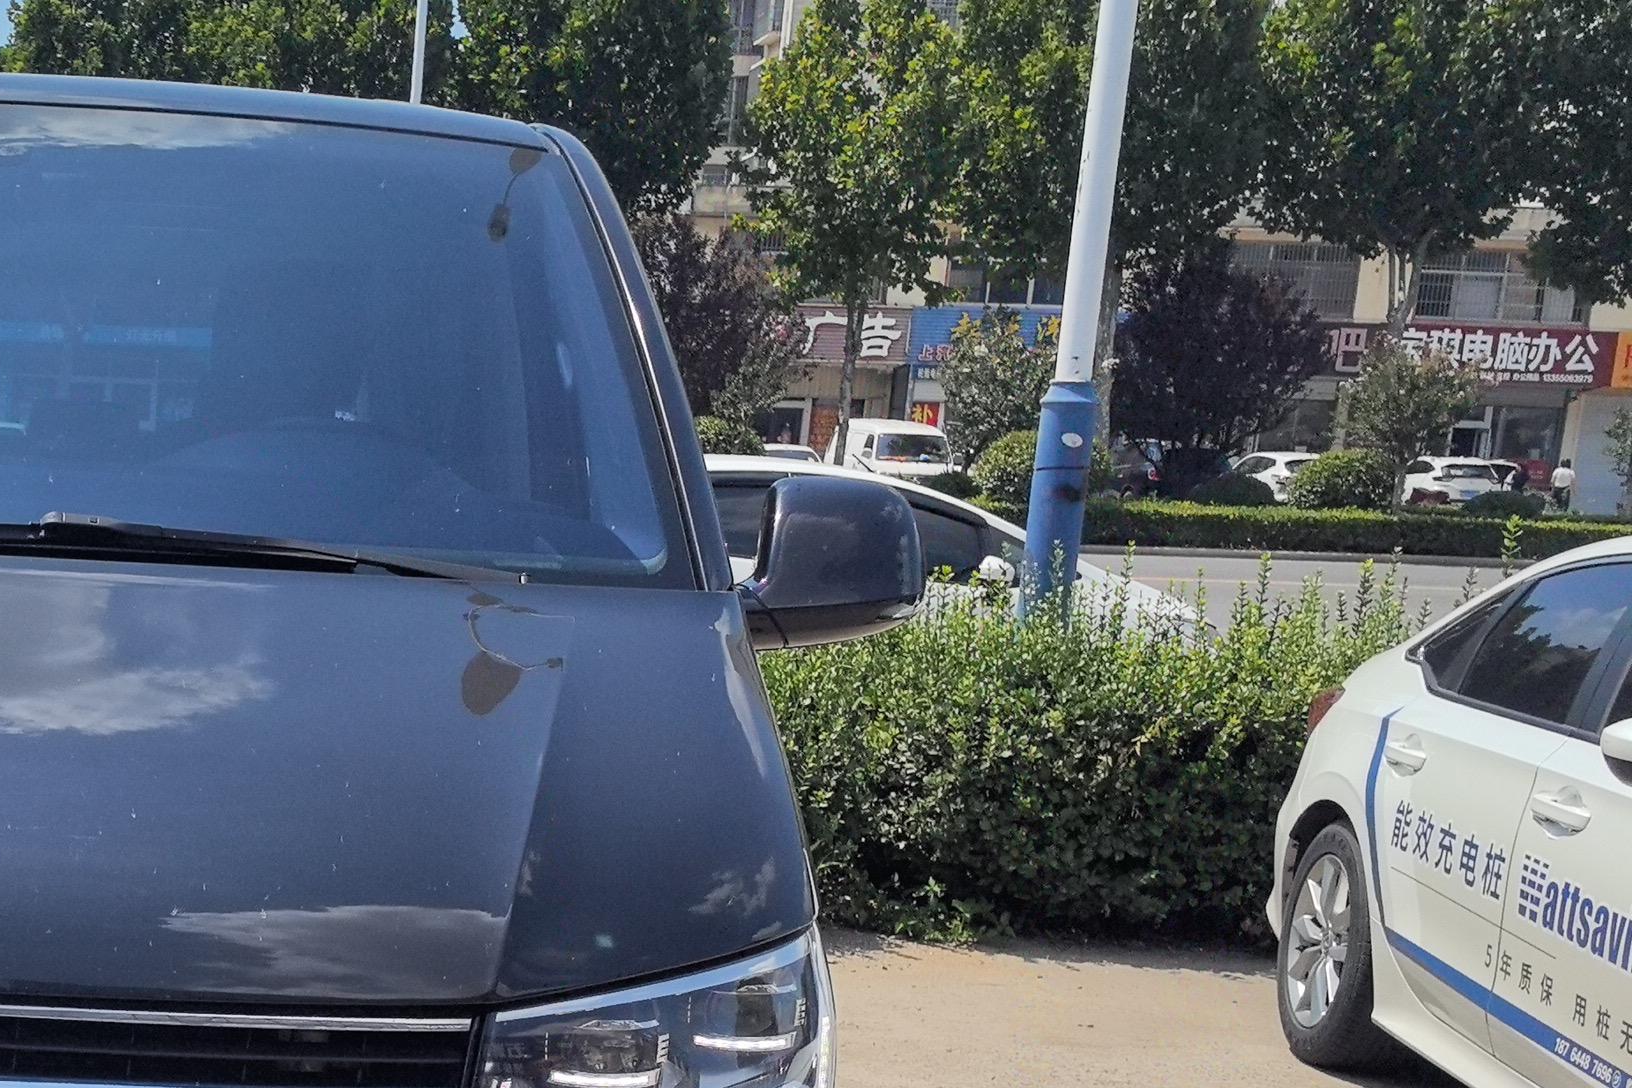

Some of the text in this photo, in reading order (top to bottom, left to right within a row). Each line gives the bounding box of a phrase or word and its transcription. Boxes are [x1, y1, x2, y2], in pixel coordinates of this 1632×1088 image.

[1390, 800, 1507, 901] 能效充电桩
[1484, 944, 1554, 1007] 5年质保
[1554, 1037, 1613, 1083] 187 6448 7696
